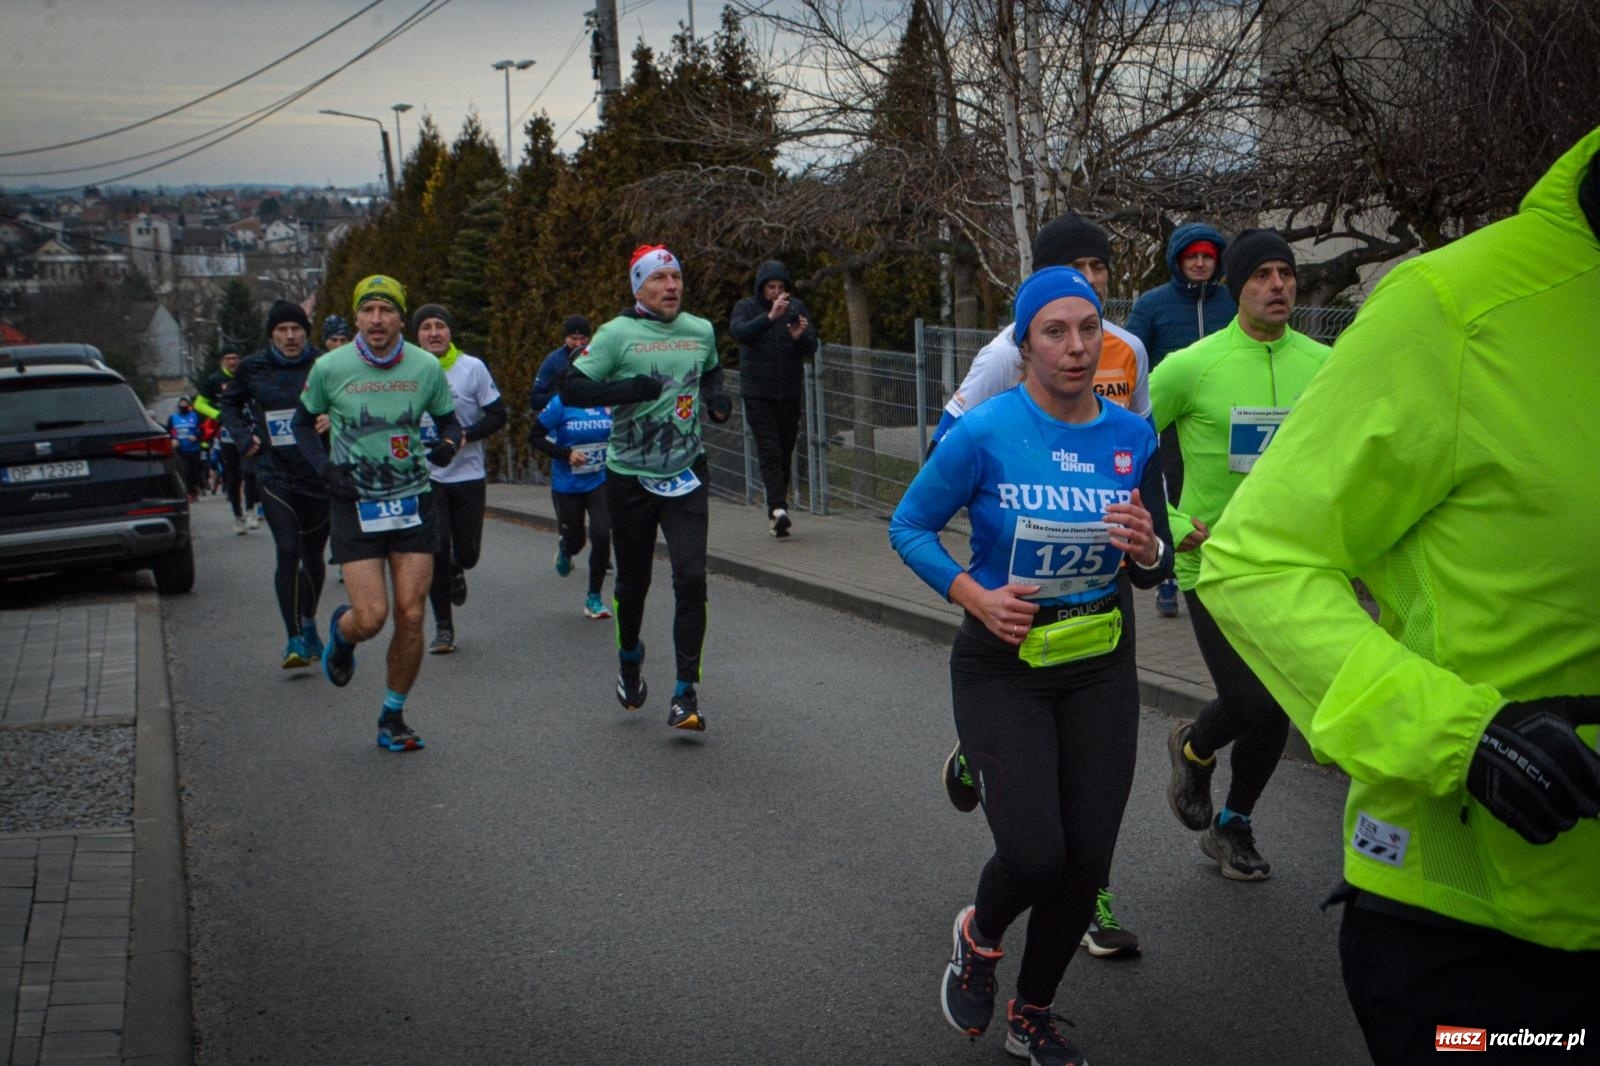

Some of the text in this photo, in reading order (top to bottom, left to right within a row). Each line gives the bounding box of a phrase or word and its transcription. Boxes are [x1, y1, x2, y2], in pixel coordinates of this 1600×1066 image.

[635, 340, 700, 353] CURSORES
[345, 380, 418, 394] CURSORES
[566, 419, 612, 430] RUNNE
[12, 462, 86, 481] OP 1239P
[376, 500, 404, 517] 18
[1034, 544, 1107, 577] 125
